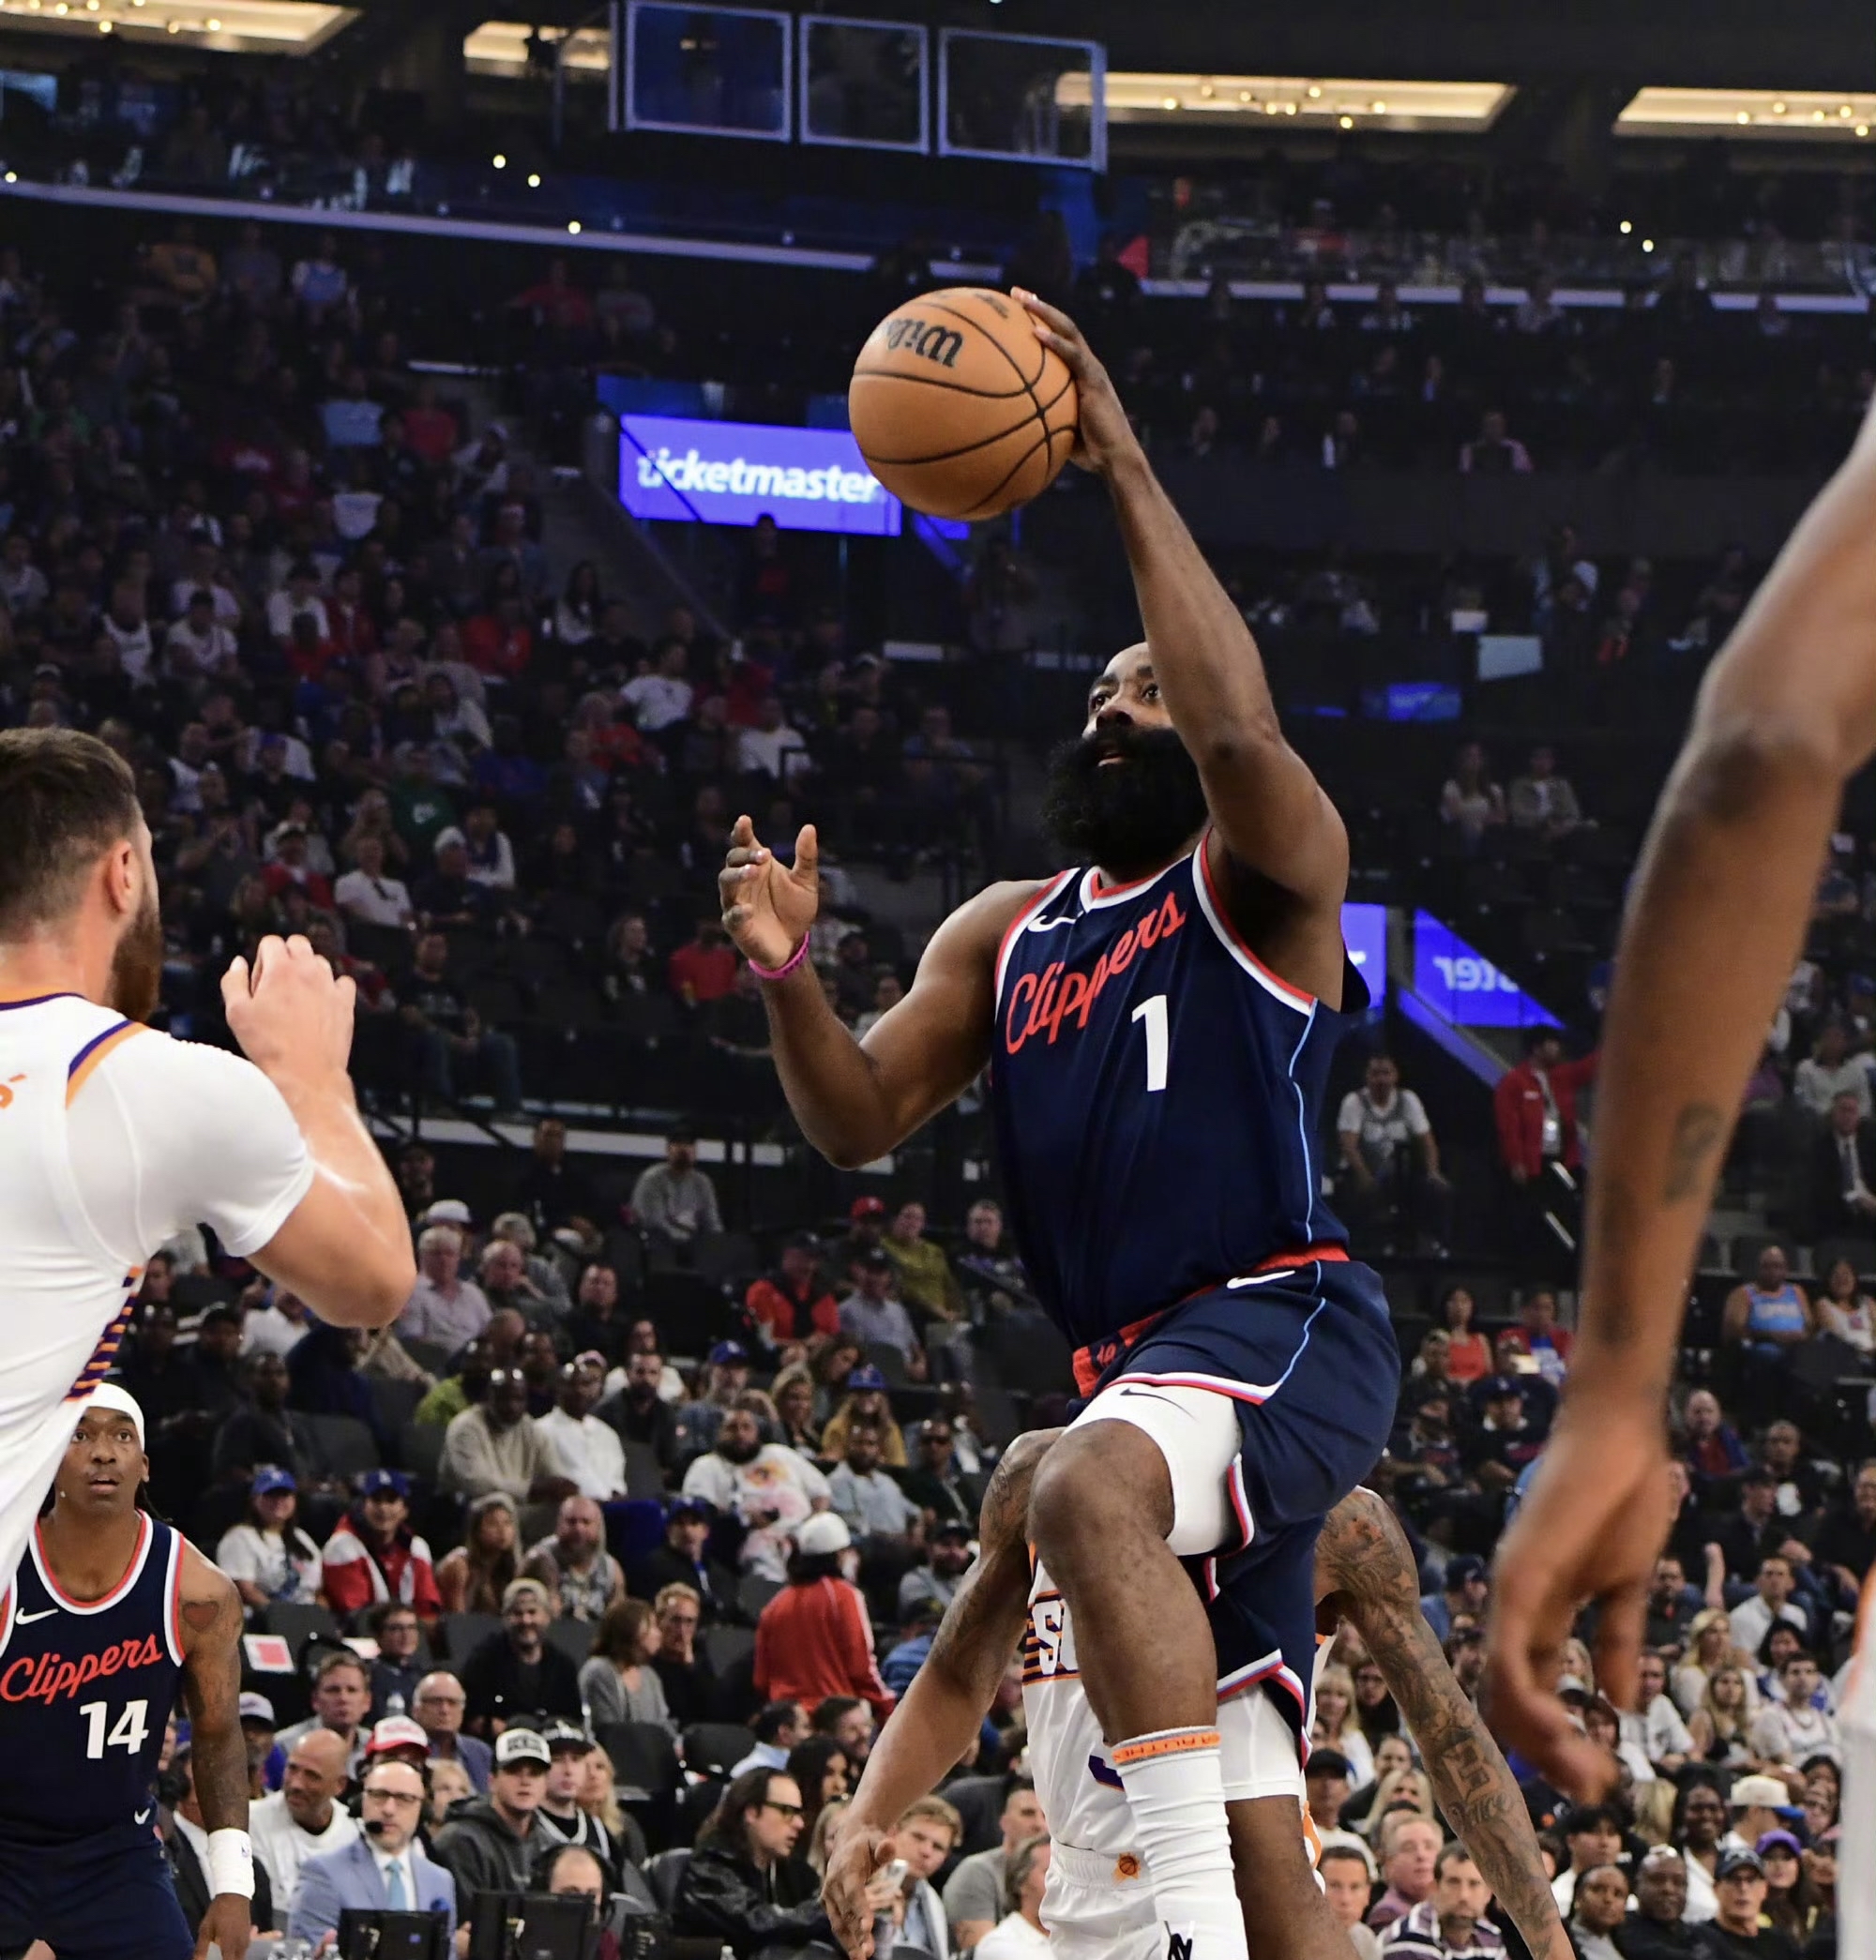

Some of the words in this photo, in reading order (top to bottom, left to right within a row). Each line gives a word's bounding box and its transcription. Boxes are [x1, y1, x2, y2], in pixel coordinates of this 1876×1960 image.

[637, 447, 883, 504] ticketmaster
[1006, 892, 1187, 1055] Clippers
[1131, 994, 1169, 1092] 1
[0, 1633, 163, 1705] Clippers
[80, 1699, 150, 1759] 14
